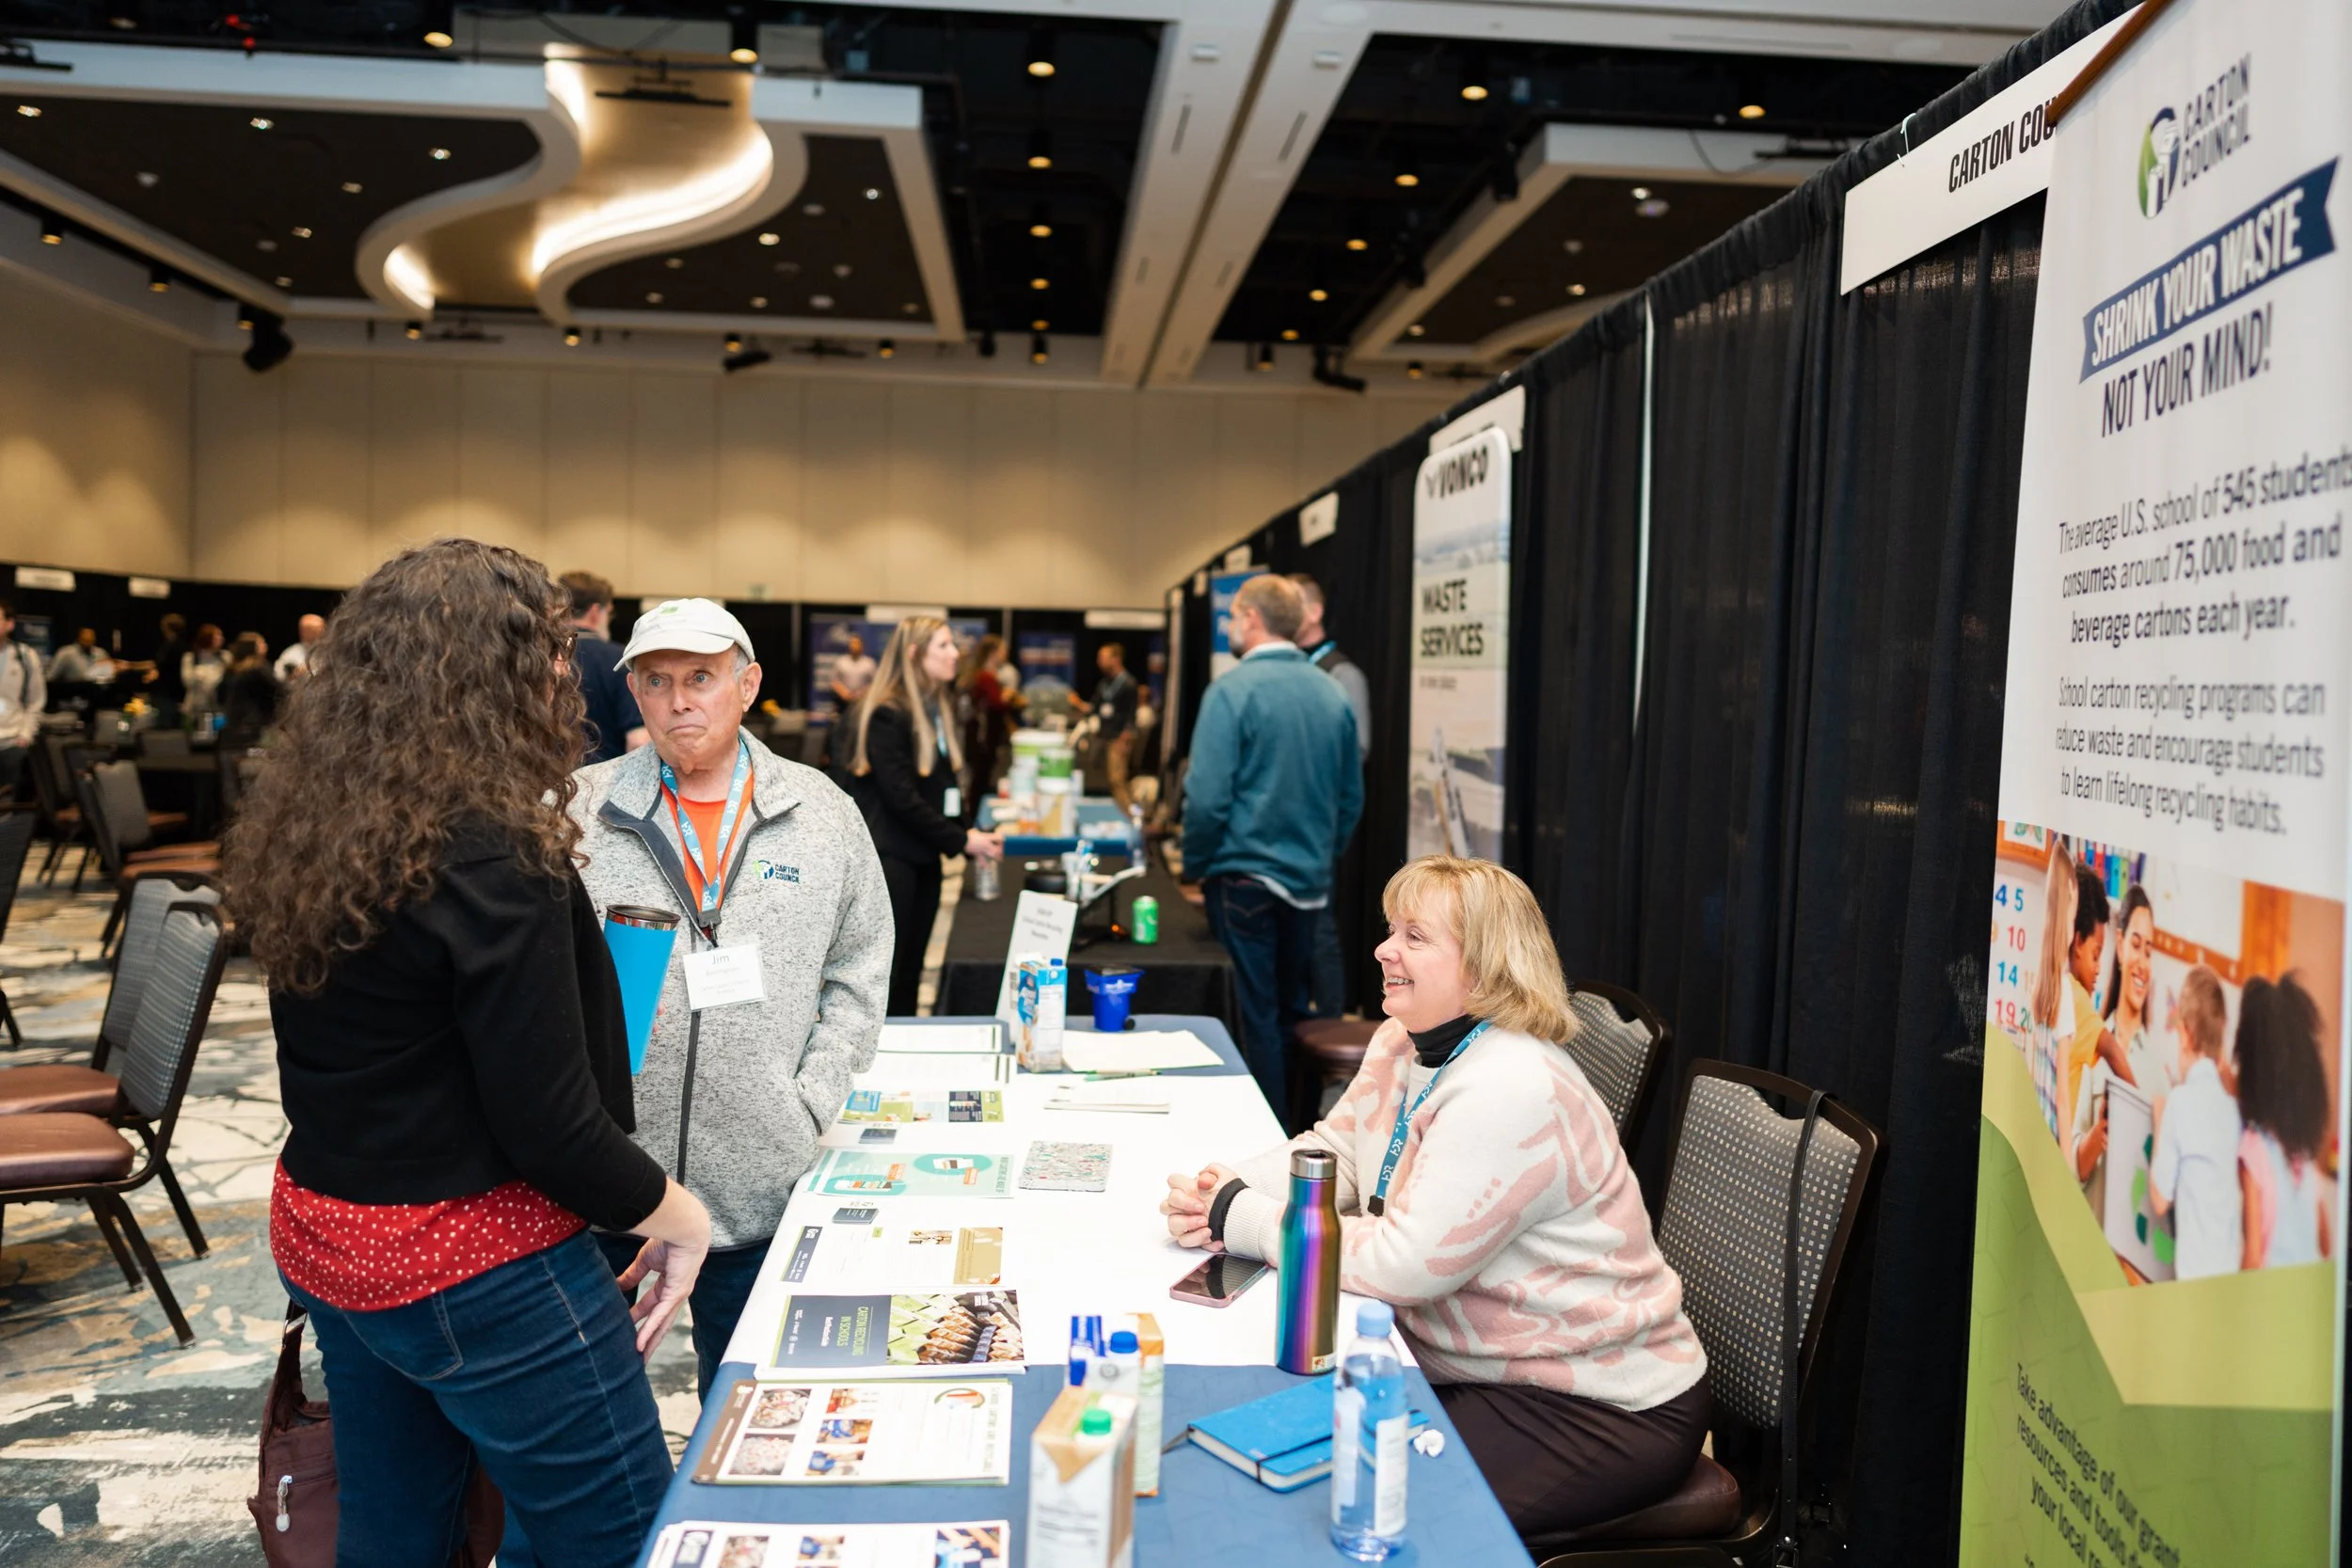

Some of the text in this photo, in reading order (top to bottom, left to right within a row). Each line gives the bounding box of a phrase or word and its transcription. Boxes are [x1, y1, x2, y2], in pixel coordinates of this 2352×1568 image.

[2184, 53, 2251, 142] CARTON
[1948, 120, 2015, 194] CARTON
[2182, 103, 2250, 187] COUNCIL
[2091, 186, 2304, 367] SHRINK YOUR WASTE
[2102, 300, 2274, 438] NOT YOUR MIND!
[2058, 521, 2074, 554] The
[2074, 511, 2119, 551] average
[2121, 499, 2149, 539] U.S.
[2153, 482, 2198, 532] school
[2201, 475, 2220, 519] of
[2223, 466, 2256, 514] 545
[2062, 510, 2343, 599] consumes around 75,000 food and
[1422, 579, 1466, 613] WASTE
[2071, 590, 2296, 649] beverage cartons each year.
[1421, 624, 1483, 657] SERVICES
[2058, 675, 2326, 721] School carton recycling programs can
[2056, 724, 2325, 779] reduce waste and encourage students
[2060, 767, 2287, 835] to learn lifelong recycling habits.
[775, 864, 800, 876] CARTON
[1994, 884, 2025, 912] 4 5
[712, 954, 730, 965] Jim
[2008, 926, 2026, 952] 10
[1996, 961, 2018, 987] 14
[1995, 999, 2017, 1027] 19
[1381, 1164, 1394, 1181] HDR
[1390, 1138, 1403, 1156] HDR
[2017, 1362, 2036, 1411] Take
[2037, 1398, 2098, 1483] advantage
[2100, 1468, 2116, 1501] of
[2116, 1489, 2138, 1531] our
[2016, 1414, 2068, 1493] resources
[2069, 1480, 2092, 1524] and
[2095, 1504, 2126, 1566] tools
[2031, 1476, 2057, 1522] your
[2058, 1503, 2087, 1563] local
